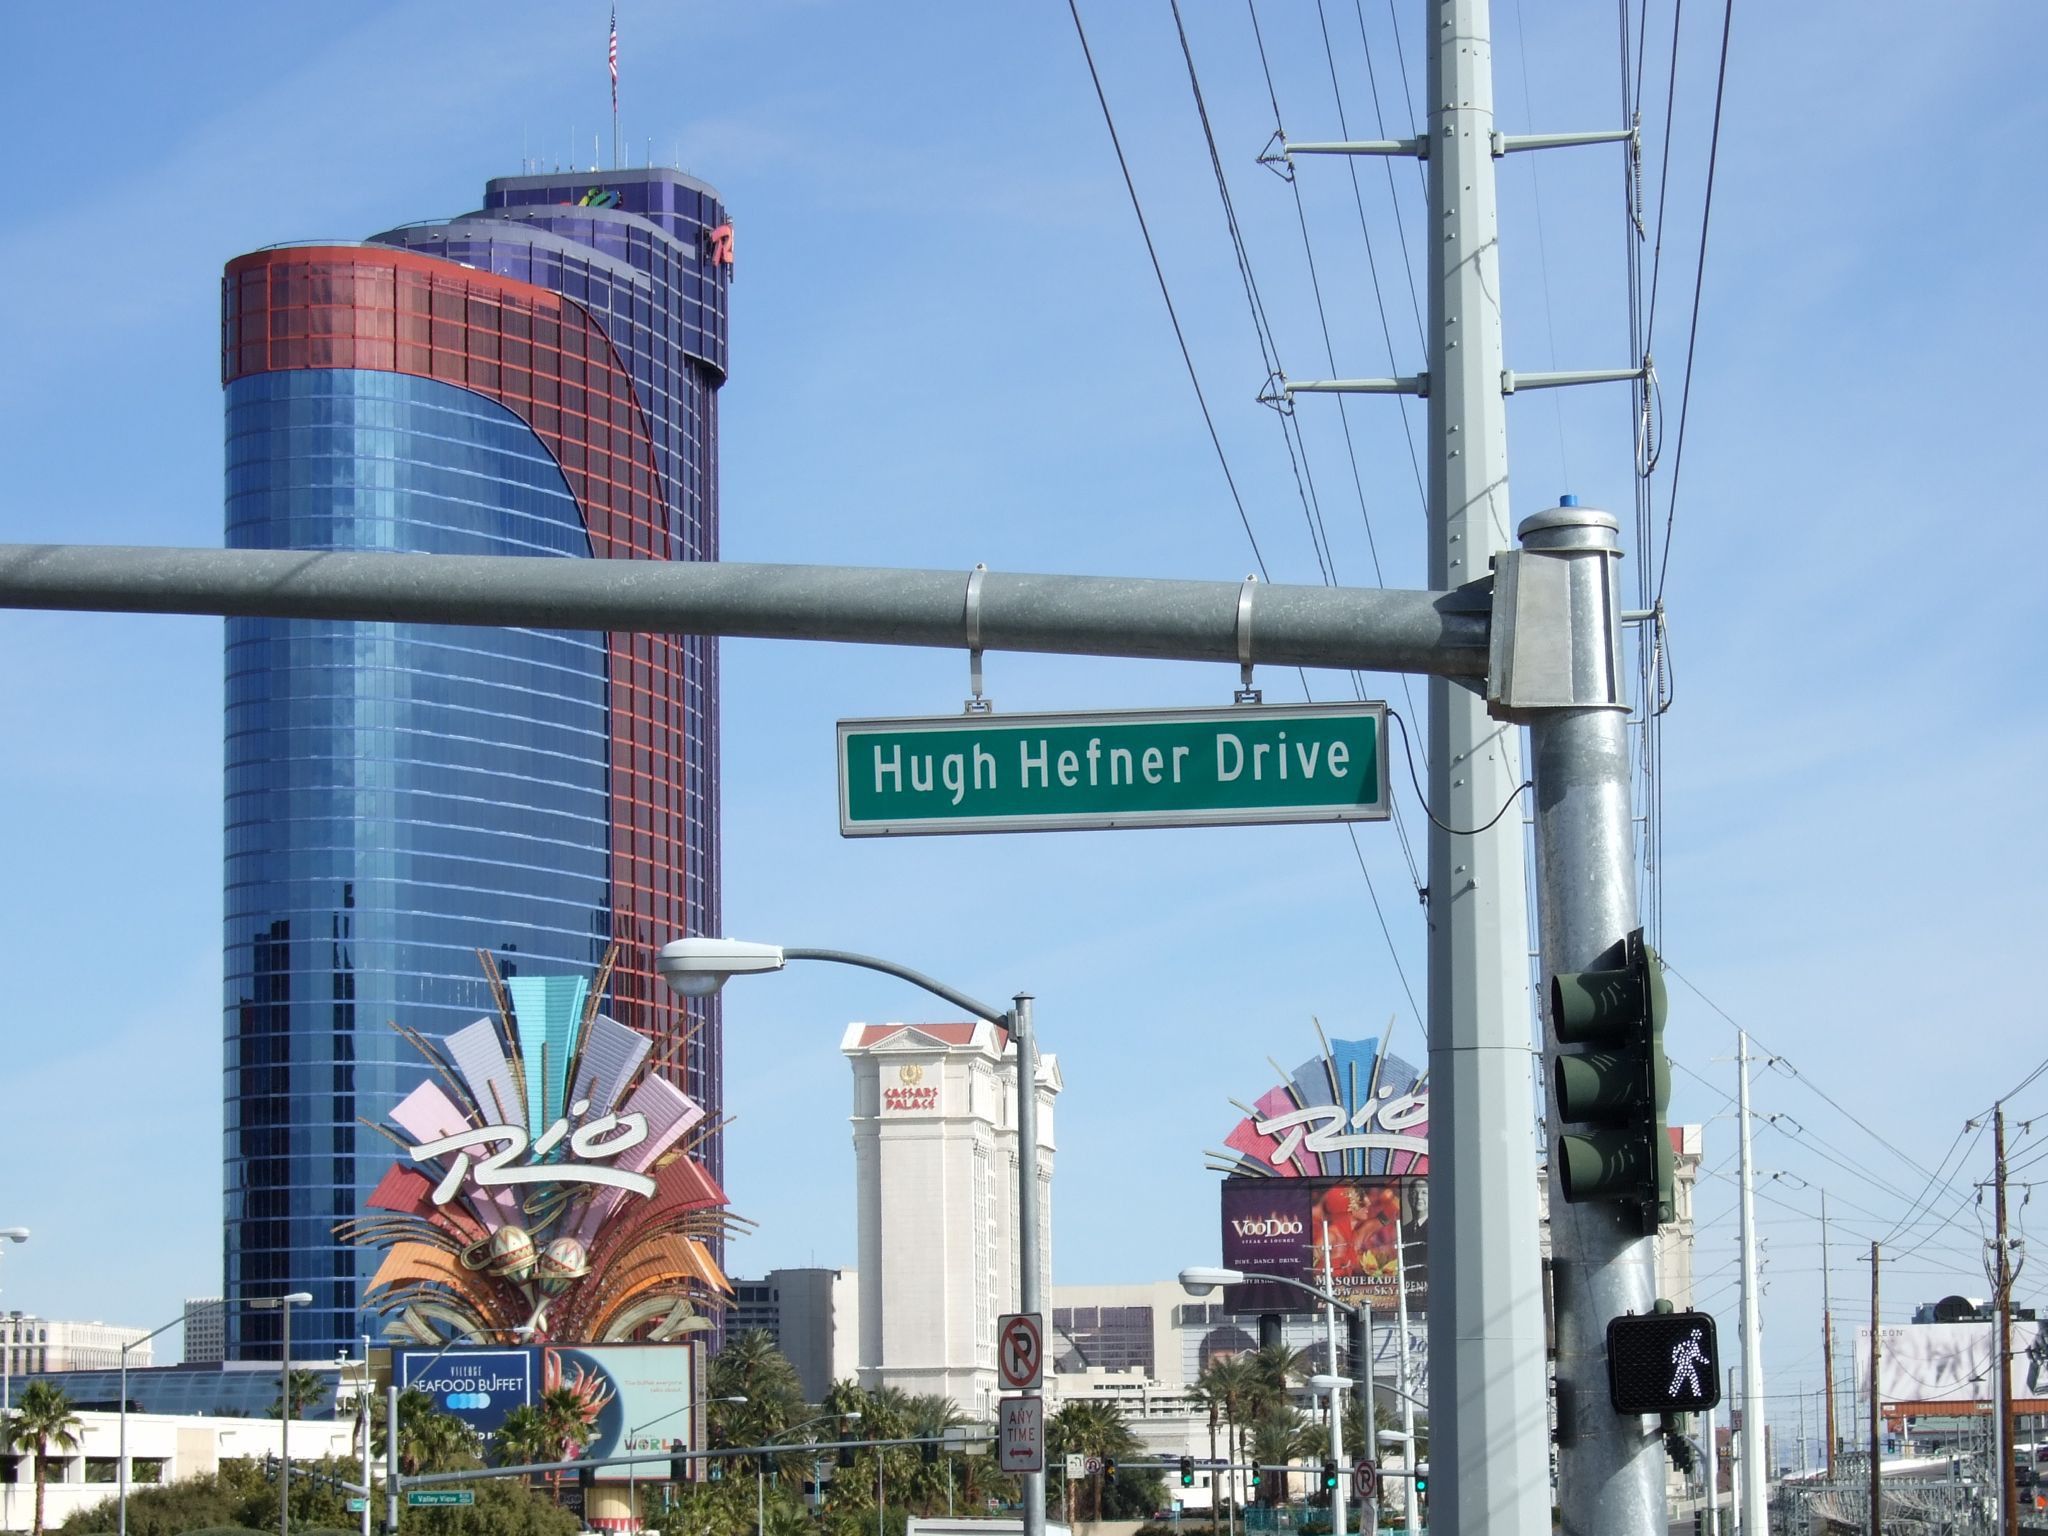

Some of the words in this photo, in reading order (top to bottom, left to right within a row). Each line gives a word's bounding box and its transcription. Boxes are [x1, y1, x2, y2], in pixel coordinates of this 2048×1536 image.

[873, 741, 998, 806] Hugh
[1019, 737, 1190, 789] Hefner
[1215, 730, 1351, 783] Drive
[883, 1087, 939, 1100] CAESARS
[885, 1099, 936, 1111] PALACE
[1255, 1084, 1429, 1165] Rio
[409, 1098, 657, 1206] Rio
[450, 1366, 482, 1377] VILLAGE
[412, 1378, 476, 1393] SEAFOOD
[478, 1372, 524, 1391] BUFFET
[1008, 1410, 1034, 1425] ANY
[1007, 1427, 1036, 1442] TIME
